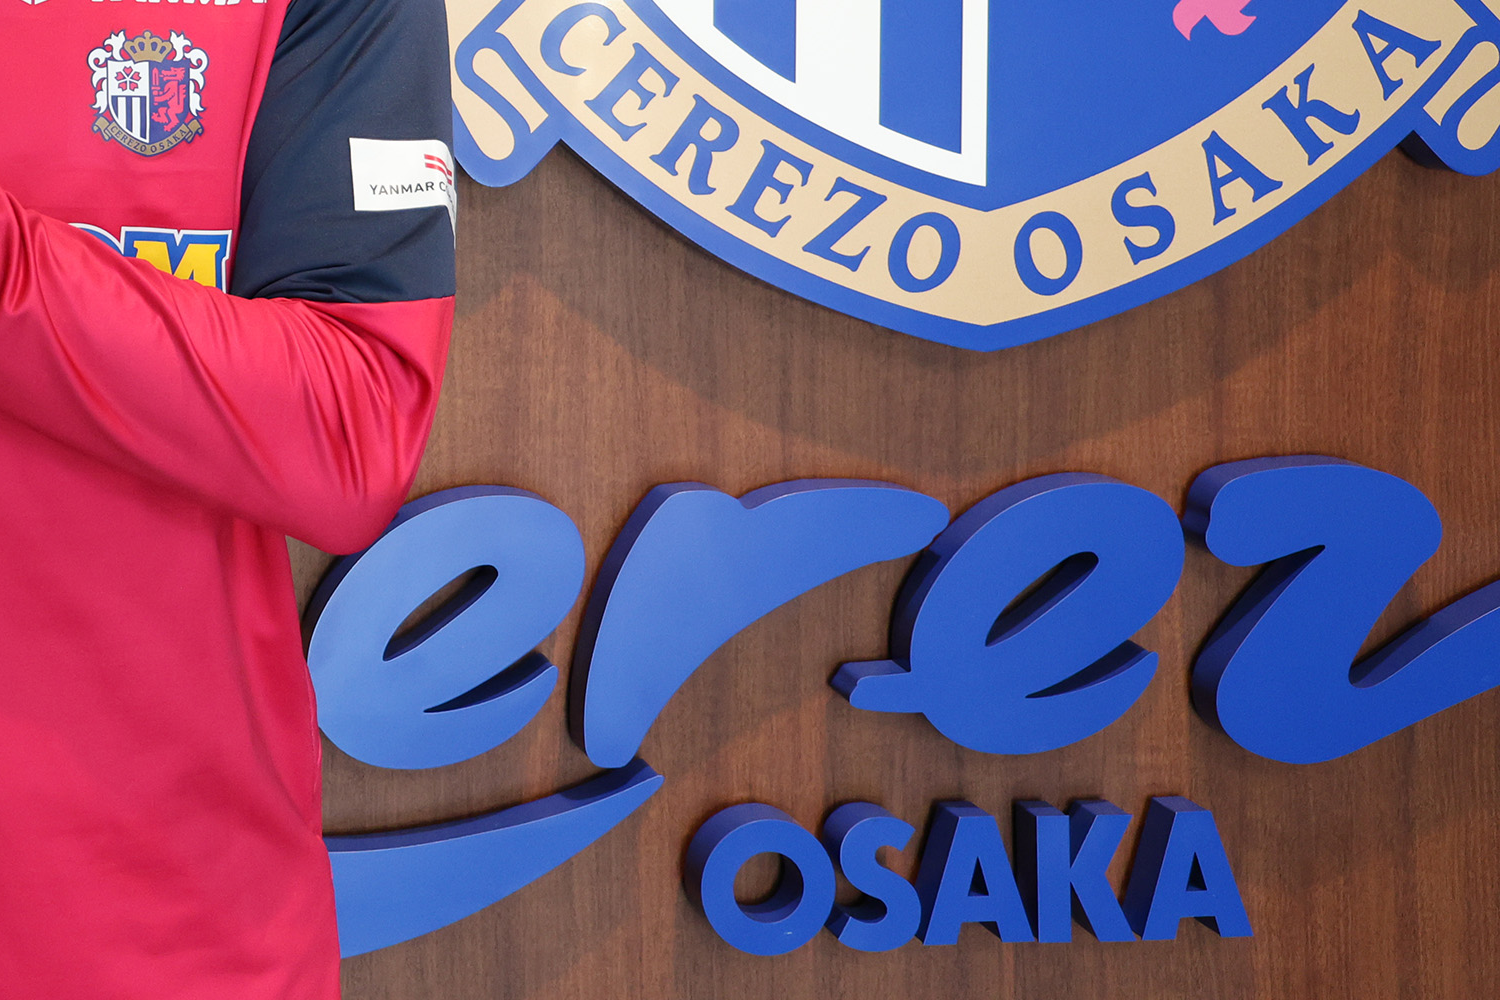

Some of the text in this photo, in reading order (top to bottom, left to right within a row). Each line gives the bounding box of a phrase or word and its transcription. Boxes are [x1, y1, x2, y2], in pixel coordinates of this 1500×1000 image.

[110, 125, 187, 153] CEREZO OSAKA
[540, 2, 1441, 296] CEREZO OSAKA
[369, 181, 435, 195] YANMAR
[686, 797, 1253, 956] OSAKA
